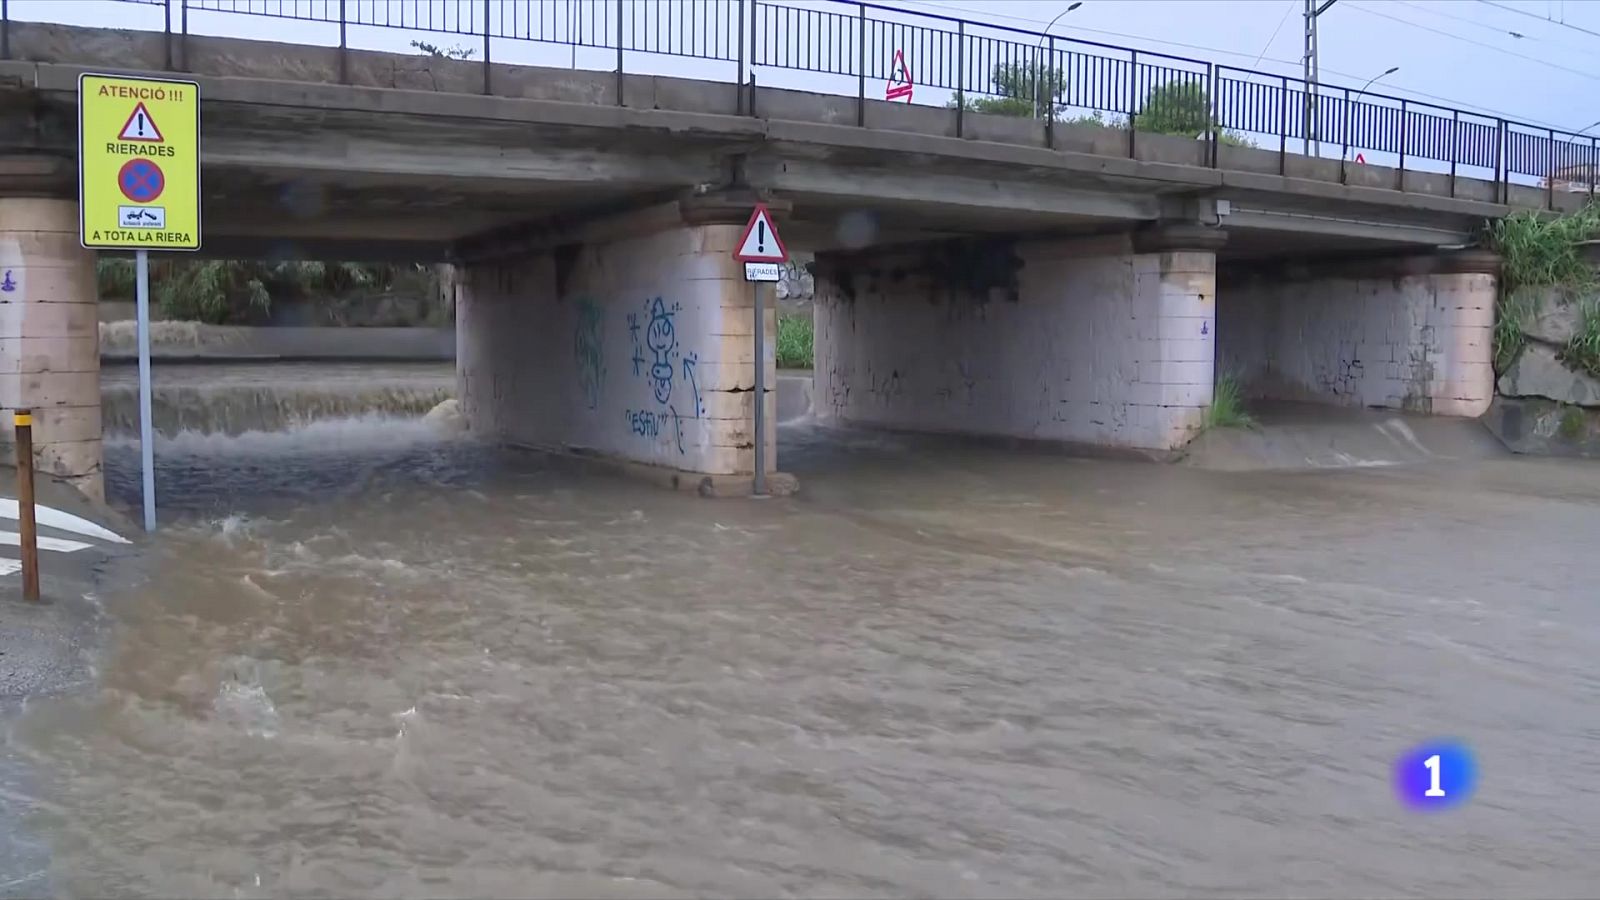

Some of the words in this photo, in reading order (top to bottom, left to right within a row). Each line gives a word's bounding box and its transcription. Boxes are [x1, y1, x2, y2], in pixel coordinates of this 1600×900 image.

[98, 85, 165, 101] ATENCIÓ
[169, 90, 183, 102] !!!
[106, 143, 175, 157] RIERADES
[92, 230, 101, 241] A
[104, 230, 135, 241] TOTA
[138, 232, 153, 242] LA
[156, 232, 191, 243] RIERA
